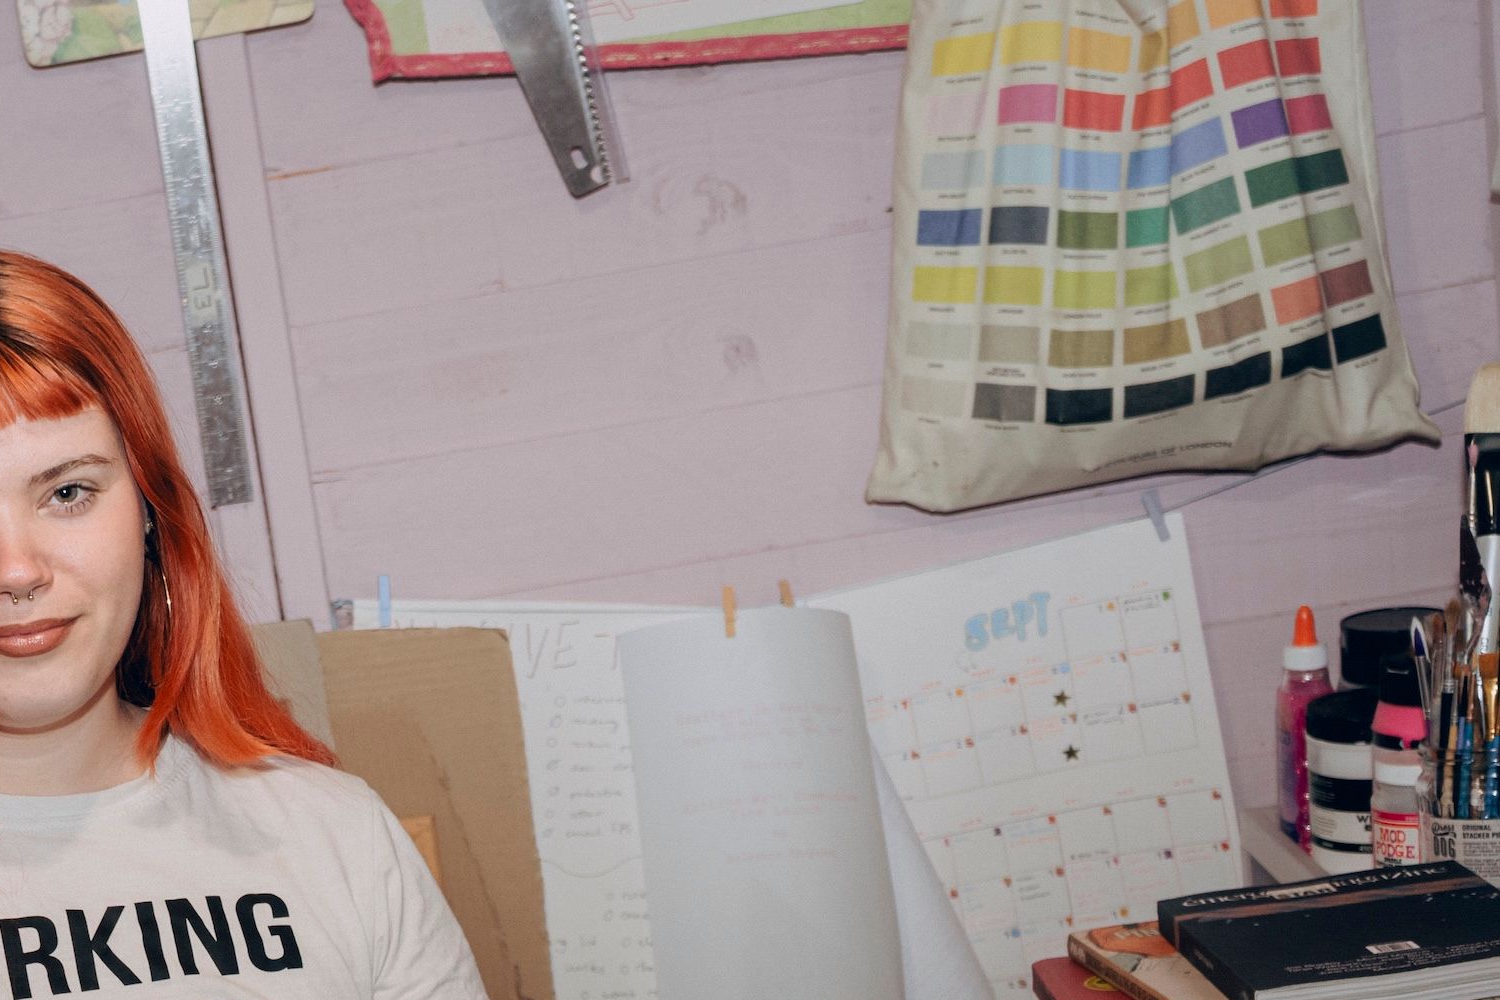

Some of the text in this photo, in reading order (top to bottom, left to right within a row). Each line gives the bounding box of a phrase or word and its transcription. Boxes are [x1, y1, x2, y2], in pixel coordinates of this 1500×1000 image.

[964, 591, 1051, 652] SEPT
[1380, 827, 1405, 843] MOD
[1376, 841, 1415, 859] PODGE
